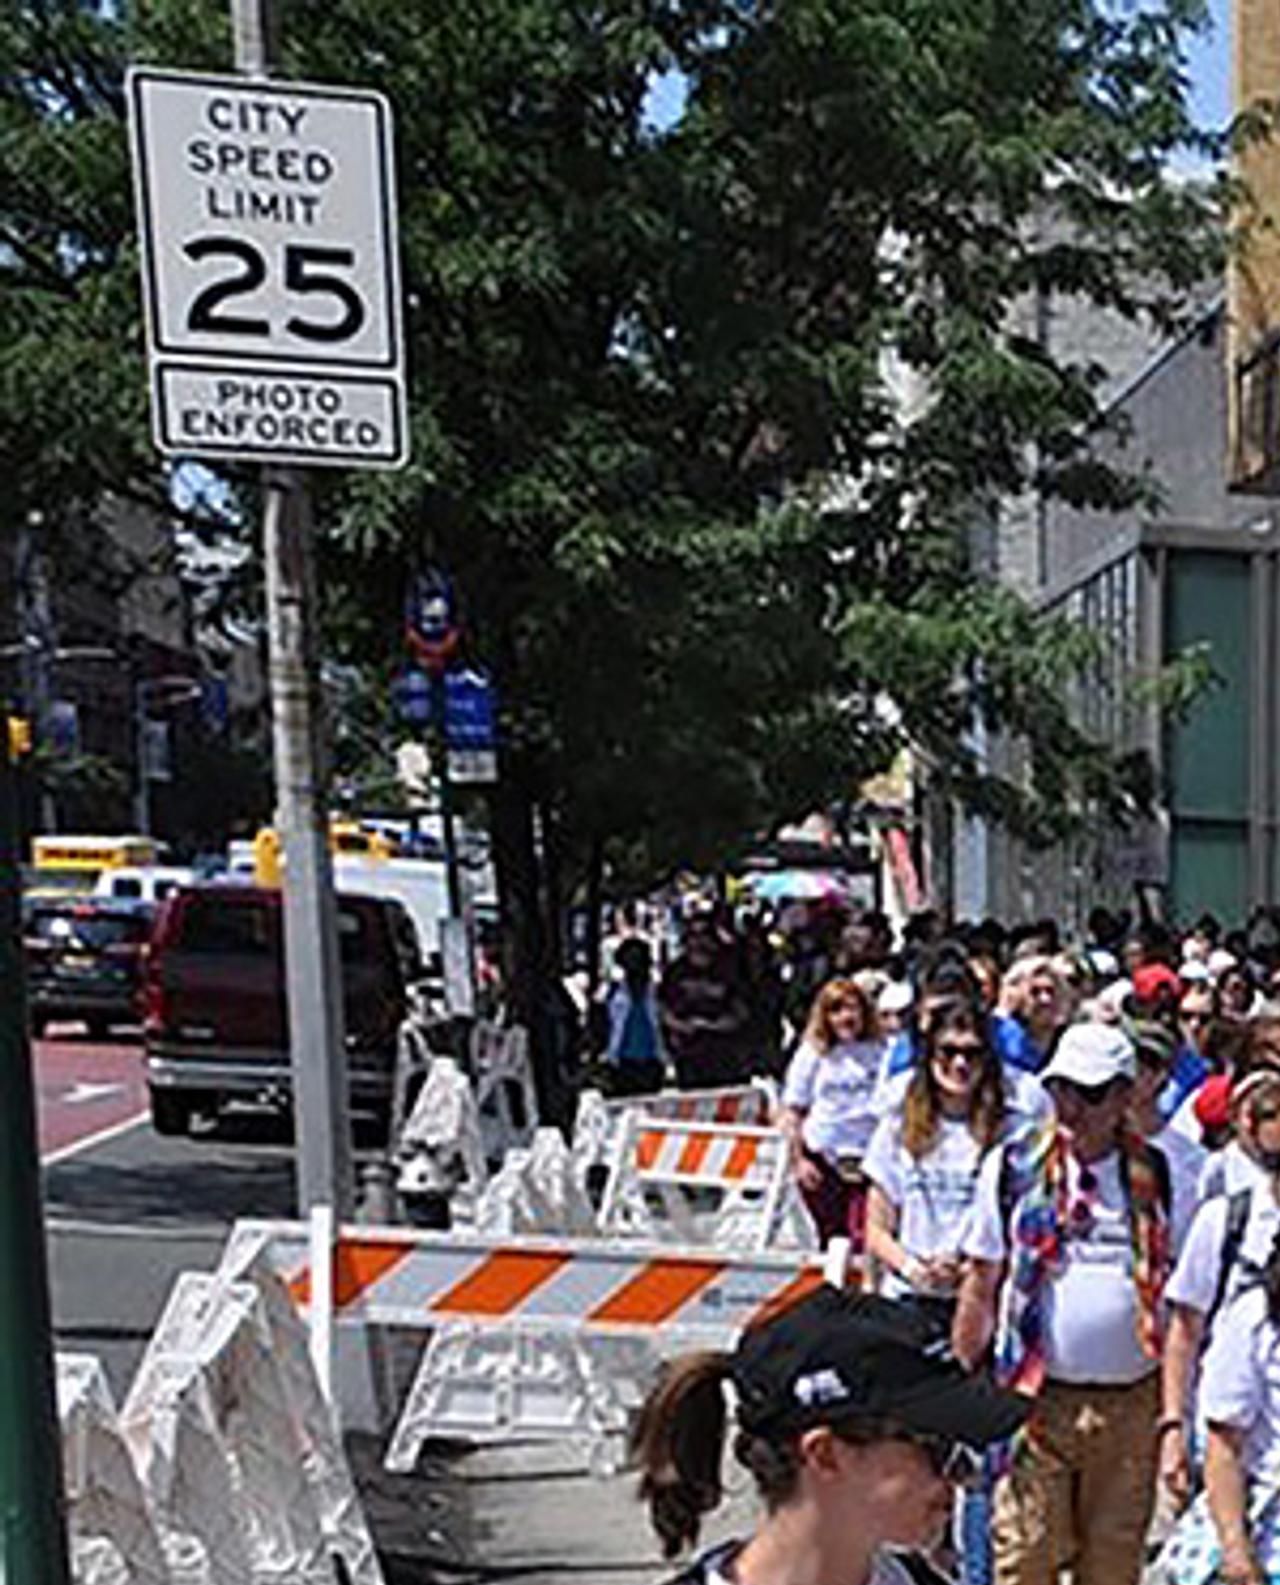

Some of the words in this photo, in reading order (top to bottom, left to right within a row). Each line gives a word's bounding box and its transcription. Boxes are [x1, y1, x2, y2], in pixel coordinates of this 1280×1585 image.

[207, 98, 306, 136] CITY
[186, 141, 334, 184] SPEED
[207, 186, 321, 224] LIMIT
[182, 236, 365, 343] 25
[217, 381, 342, 415] PHOTO
[181, 409, 382, 448] ENFORCED
